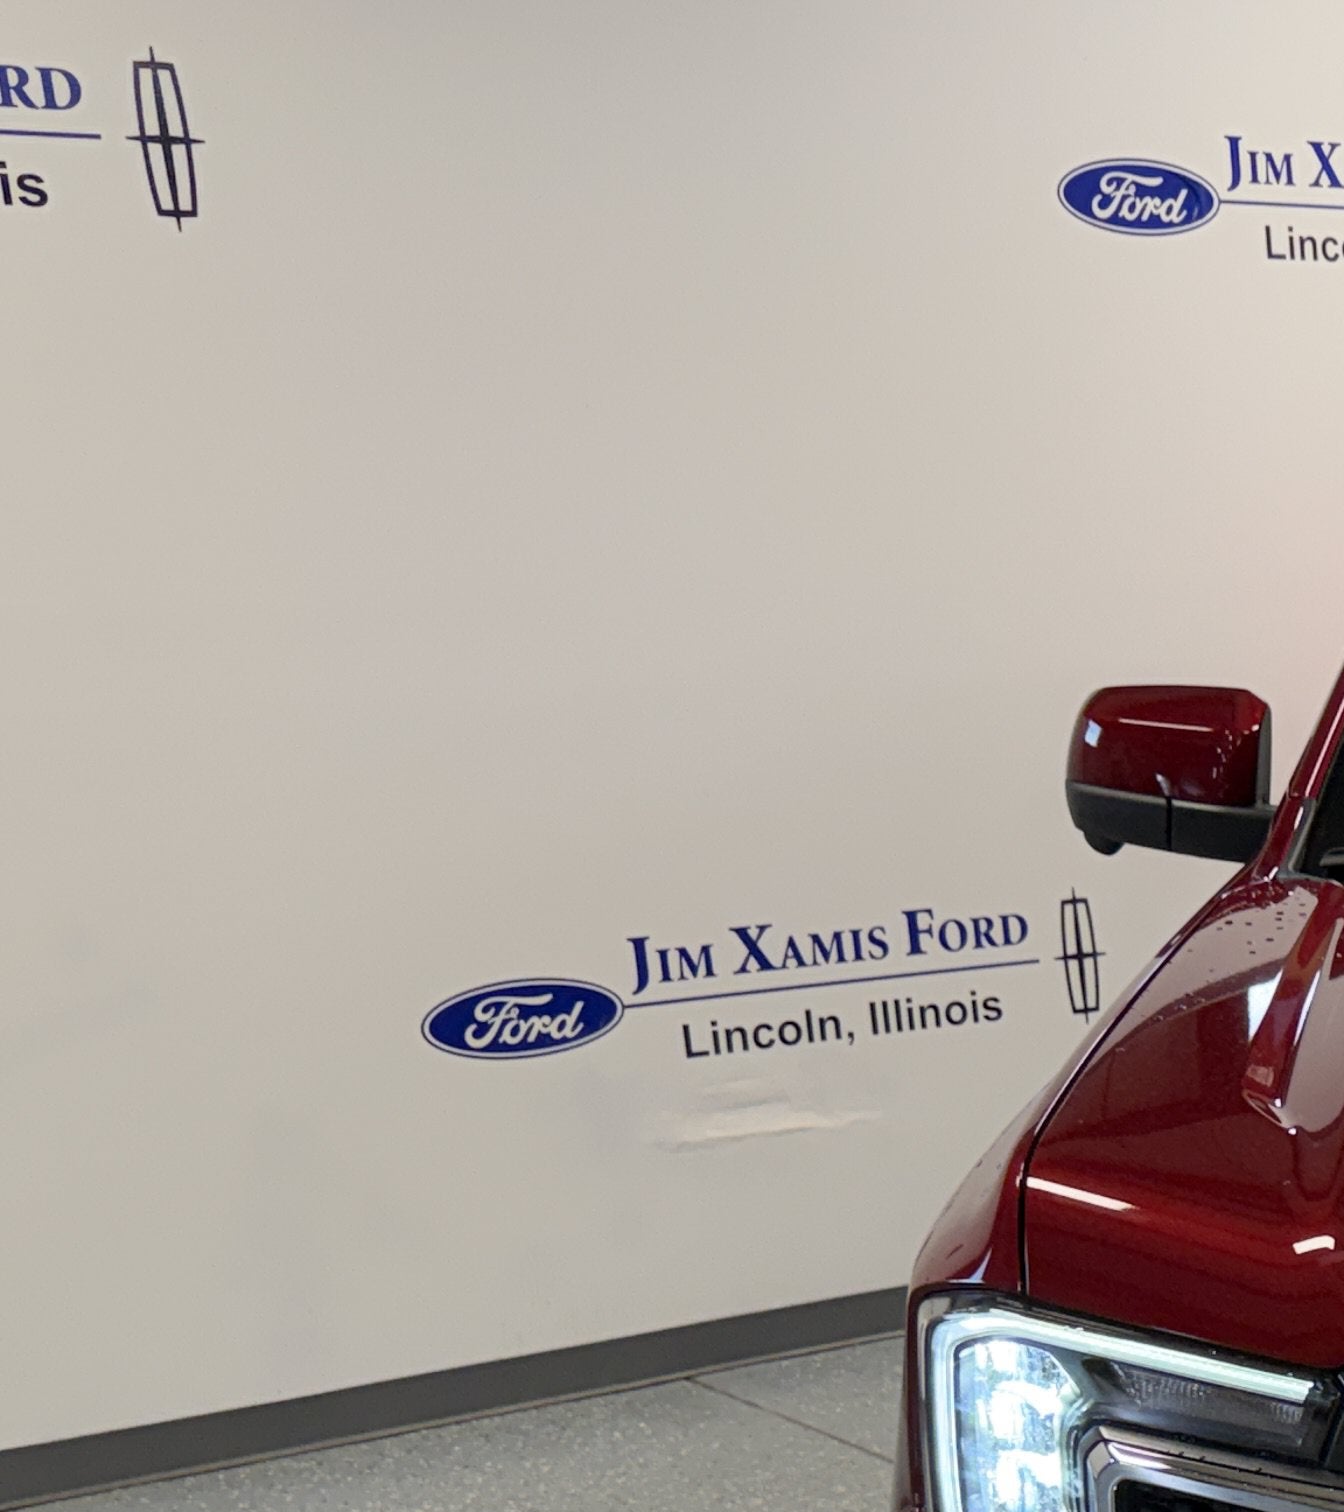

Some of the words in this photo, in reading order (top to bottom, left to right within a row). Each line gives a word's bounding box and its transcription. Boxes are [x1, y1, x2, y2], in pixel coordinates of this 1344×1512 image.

[0, 65, 81, 110] RD
[1225, 136, 1293, 191] JIM
[1091, 171, 1187, 225] Ford
[628, 937, 715, 995] JIM
[730, 925, 890, 973] XAMIS
[903, 909, 1027, 955] FORD
[463, 993, 584, 1050] Ford
[682, 1010, 855, 1059] Lincoln,
[870, 991, 1002, 1034] Illinois
